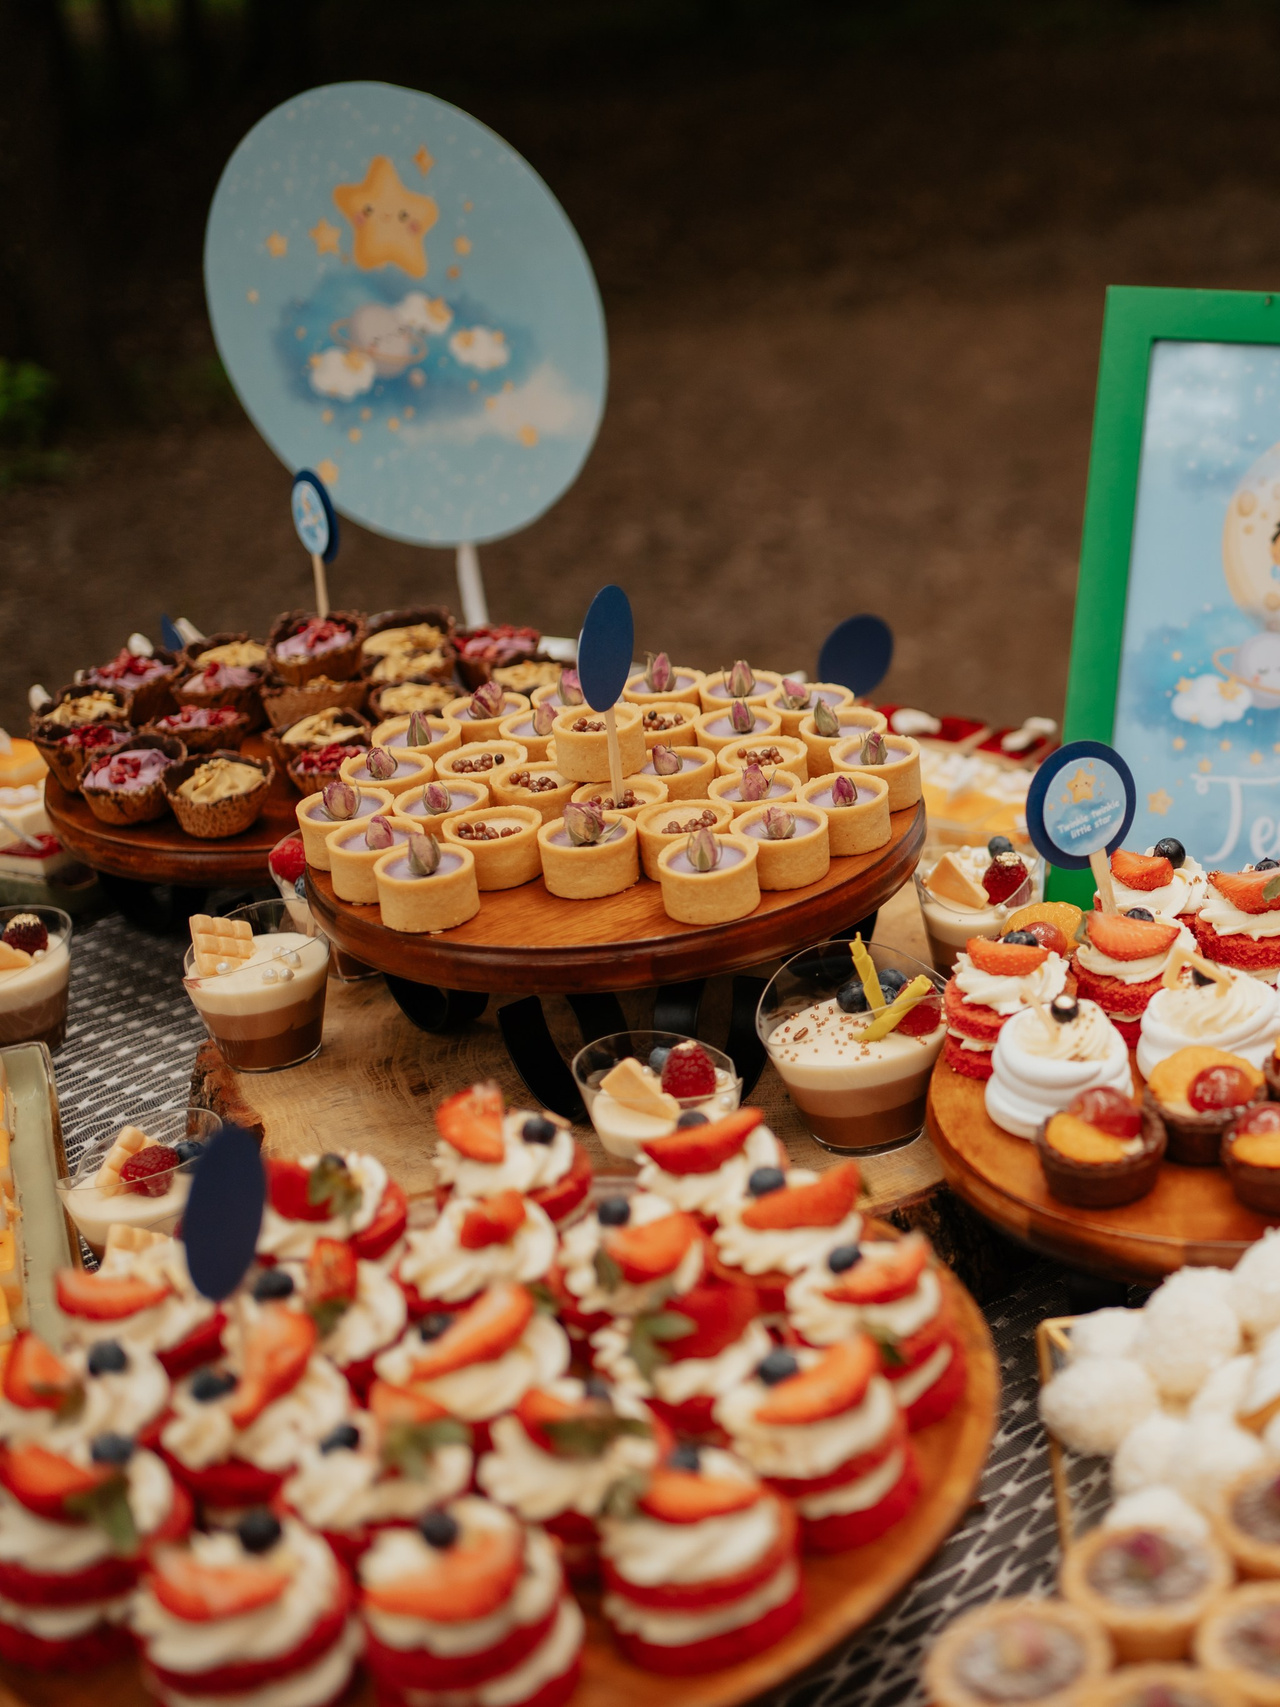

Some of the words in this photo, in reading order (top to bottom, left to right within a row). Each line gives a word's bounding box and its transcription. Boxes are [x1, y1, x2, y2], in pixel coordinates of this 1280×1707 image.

[1056, 815, 1090, 834] Twinkle
[1091, 799, 1120, 818] twinkle
[1070, 824, 1092, 839] little
[1094, 814, 1112, 829] star
